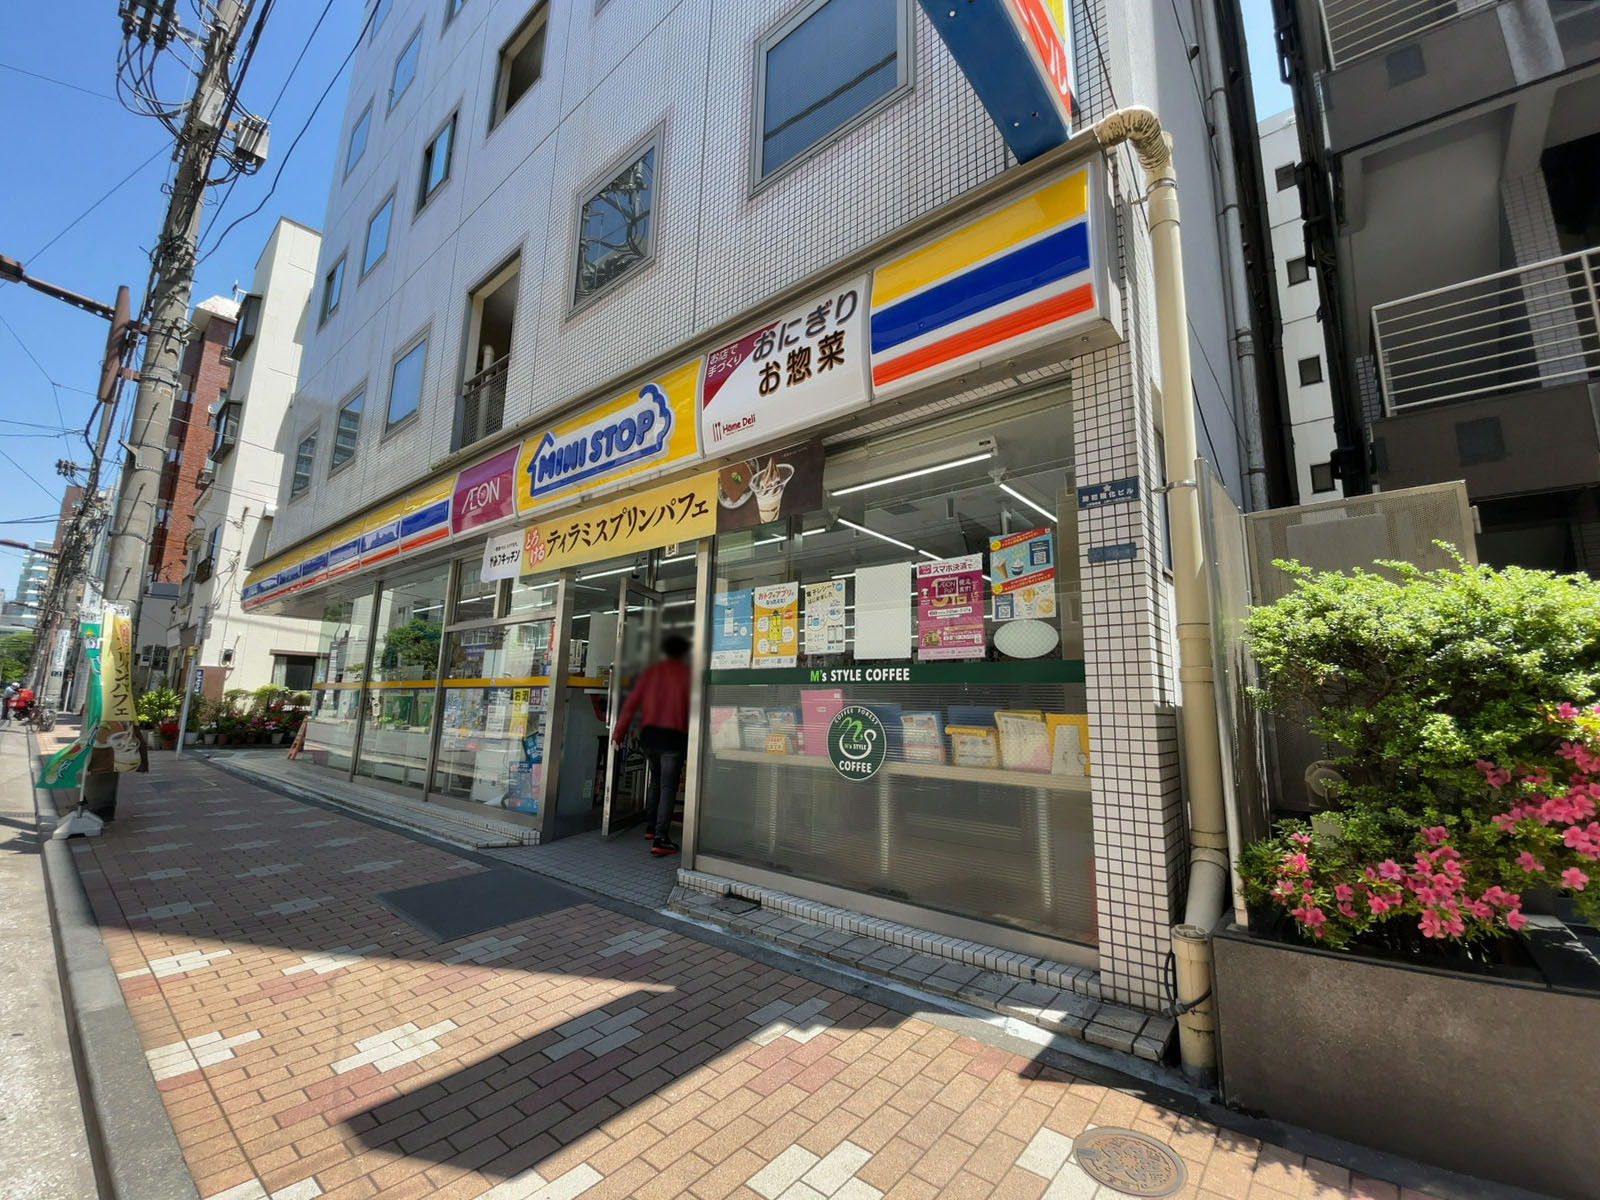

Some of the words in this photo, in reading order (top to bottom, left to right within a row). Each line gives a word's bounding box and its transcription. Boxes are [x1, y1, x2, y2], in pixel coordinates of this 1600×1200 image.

[752, 290, 858, 362] おにぎり
[710, 343, 739, 365] お店で
[758, 330, 846, 397] お惣菜
[708, 353, 742, 378] 手づくり
[722, 421, 741, 434] Home
[742, 413, 756, 427] Deli
[589, 410, 655, 463] STOP
[546, 492, 709, 558] ティラミスプリンパフェ
[932, 561, 973, 574] スマホ決済で
[810, 669, 828, 683] M's
[830, 669, 862, 681] STYLE
[865, 668, 910, 681] COFFEE
[834, 707, 855, 724] COFFEE
[857, 708, 880, 725] FOREST
[853, 743, 867, 751] STYLE
[838, 760, 873, 774] COFFEE
